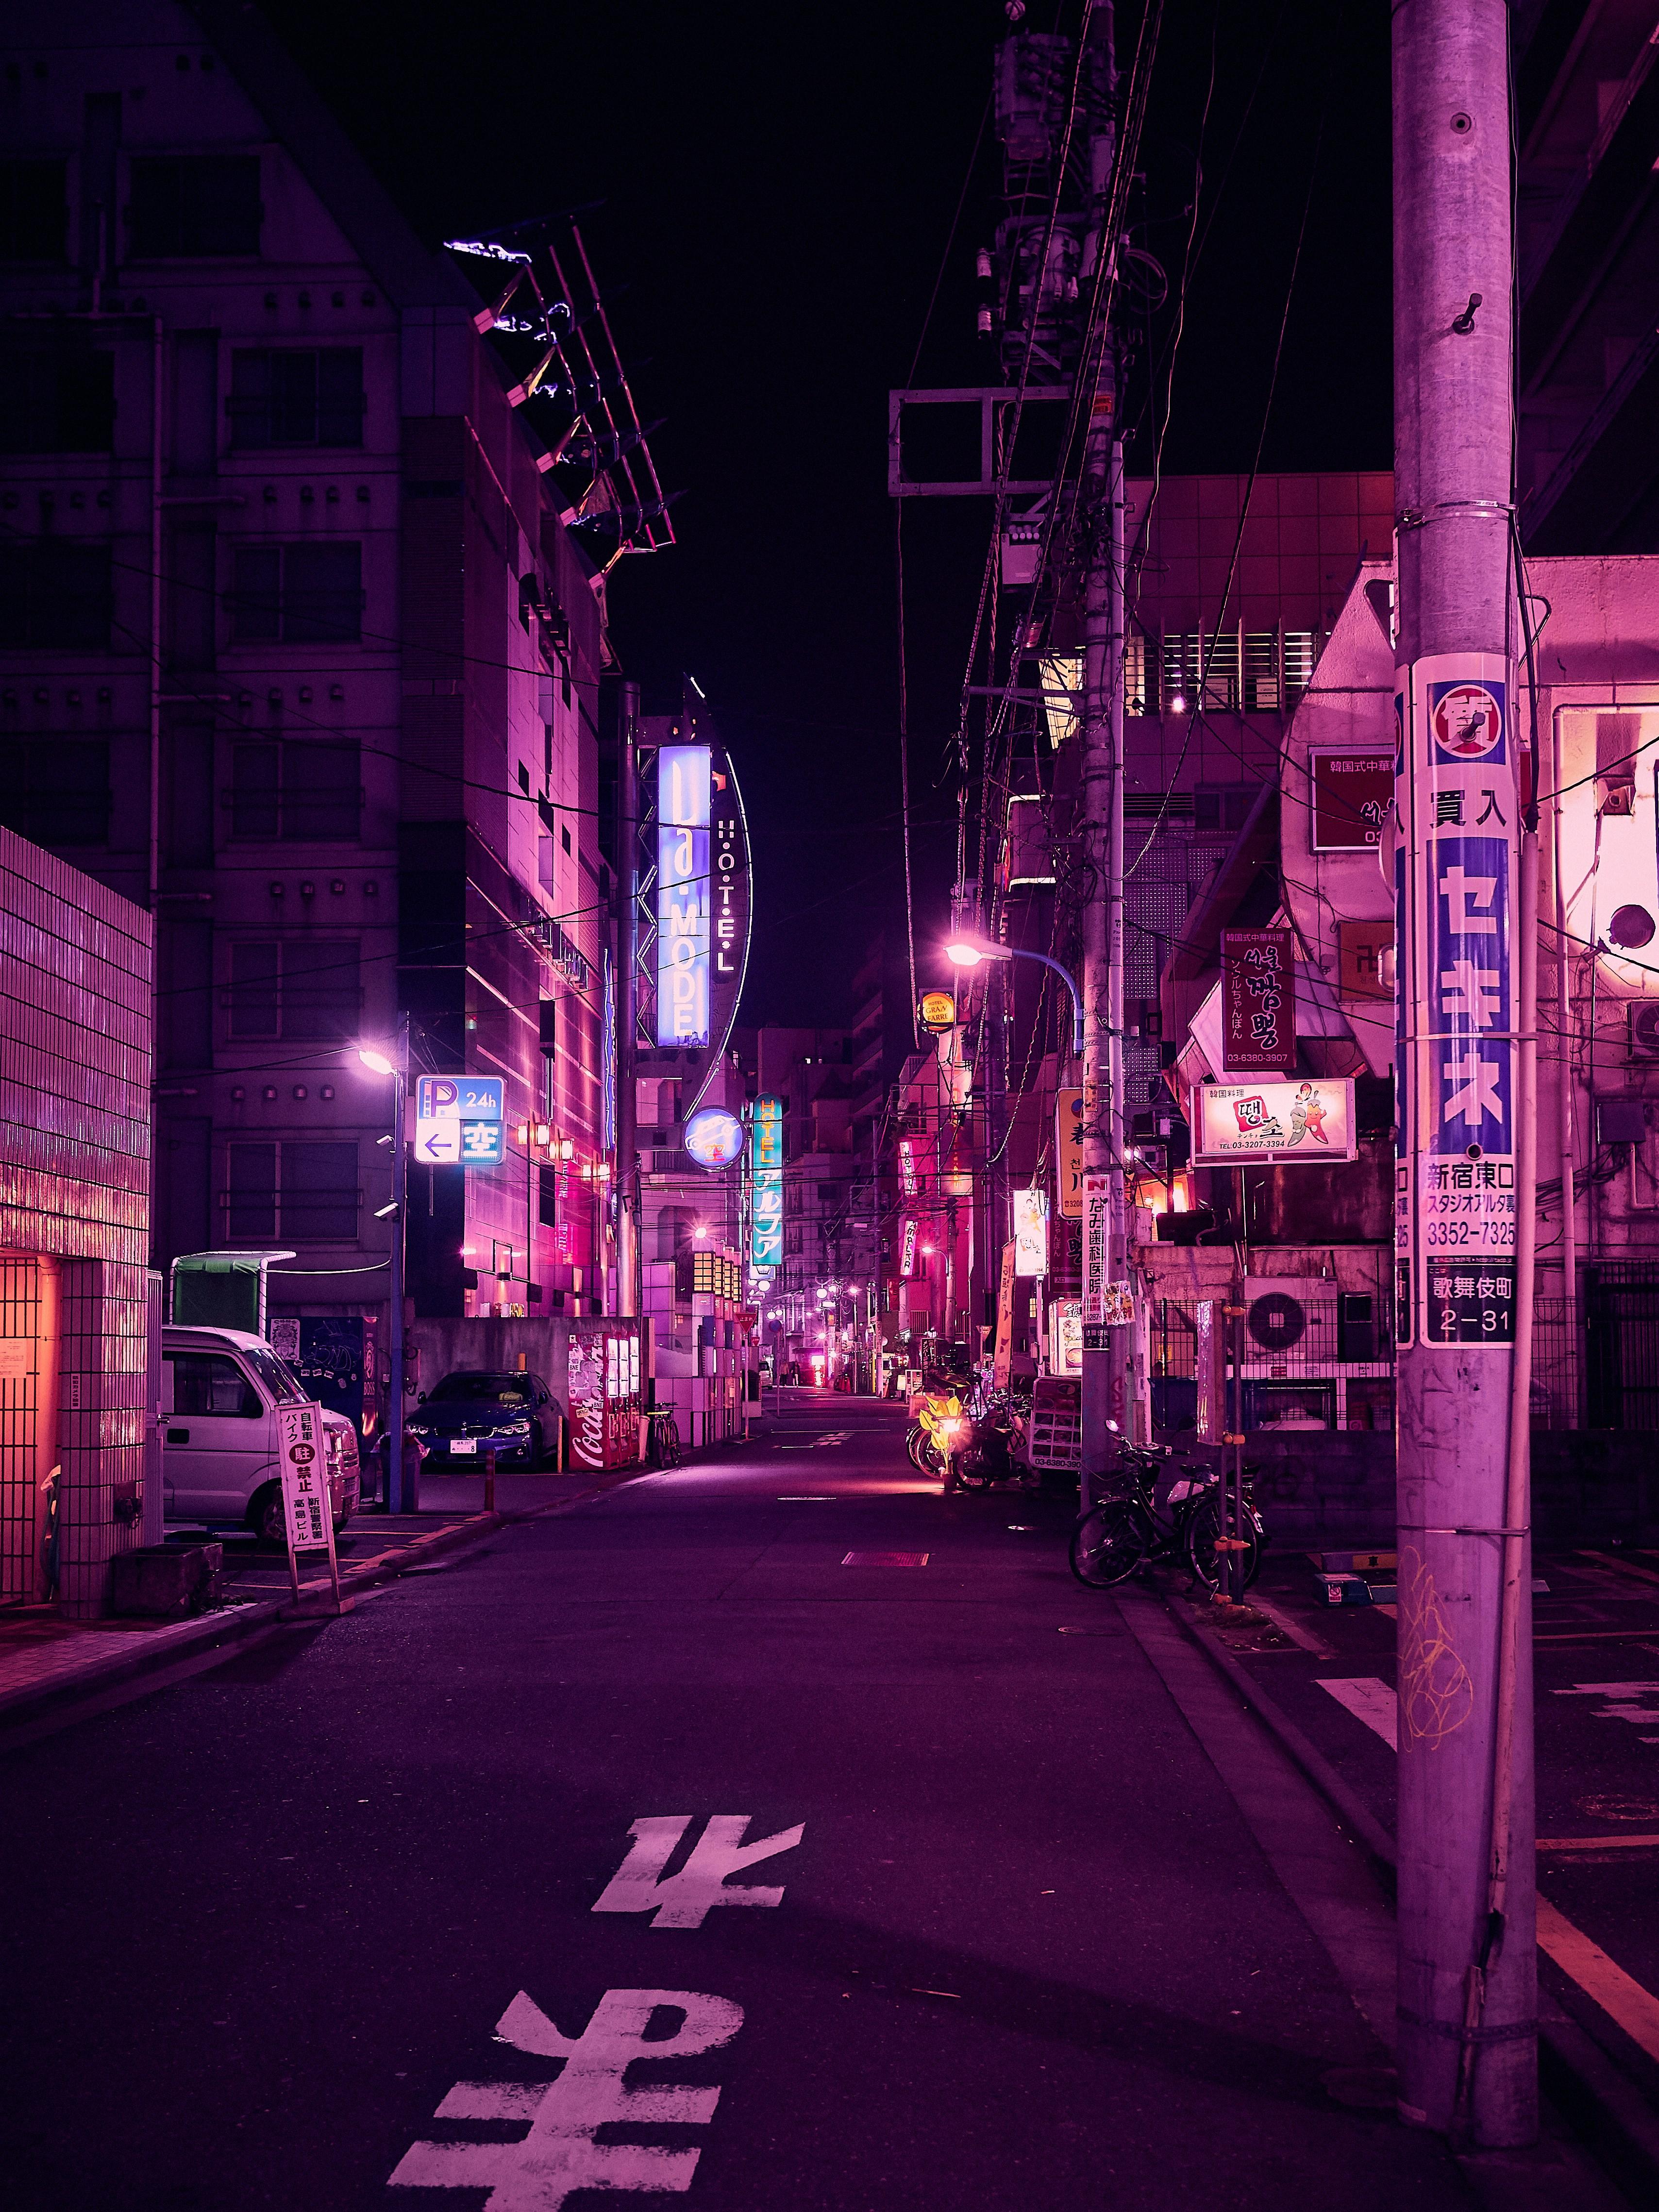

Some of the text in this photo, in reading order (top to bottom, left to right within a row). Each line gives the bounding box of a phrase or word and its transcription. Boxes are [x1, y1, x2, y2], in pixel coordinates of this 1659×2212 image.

[1430, 789, 1507, 826] 買入
[1226, 933, 1284, 941] 韓国式中華料理
[926, 1005, 947, 1013] GRAN
[1439, 866, 1503, 1125] セキネ
[431, 1080, 458, 1117] P
[466, 1092, 496, 1107] 24h
[1209, 1089, 1244, 1098] 韓国料理
[462, 1122, 499, 1157] 空
[761, 1099, 774, 1163] HOTEL
[1427, 1161, 1514, 1190] 新宿東口
[1427, 1194, 1515, 1213] スタジオアルタ裏
[1089, 1197, 1106, 1294] なみ歯科医院
[1427, 1221, 1515, 1245] 3352-7325
[1433, 1277, 1512, 1299] 歌舞伎町
[1440, 1310, 1508, 1331] 2-31
[285, 1413, 298, 1442] バイク
[301, 1412, 313, 1441] 自転車
[293, 1499, 309, 1541] 高島ビル
